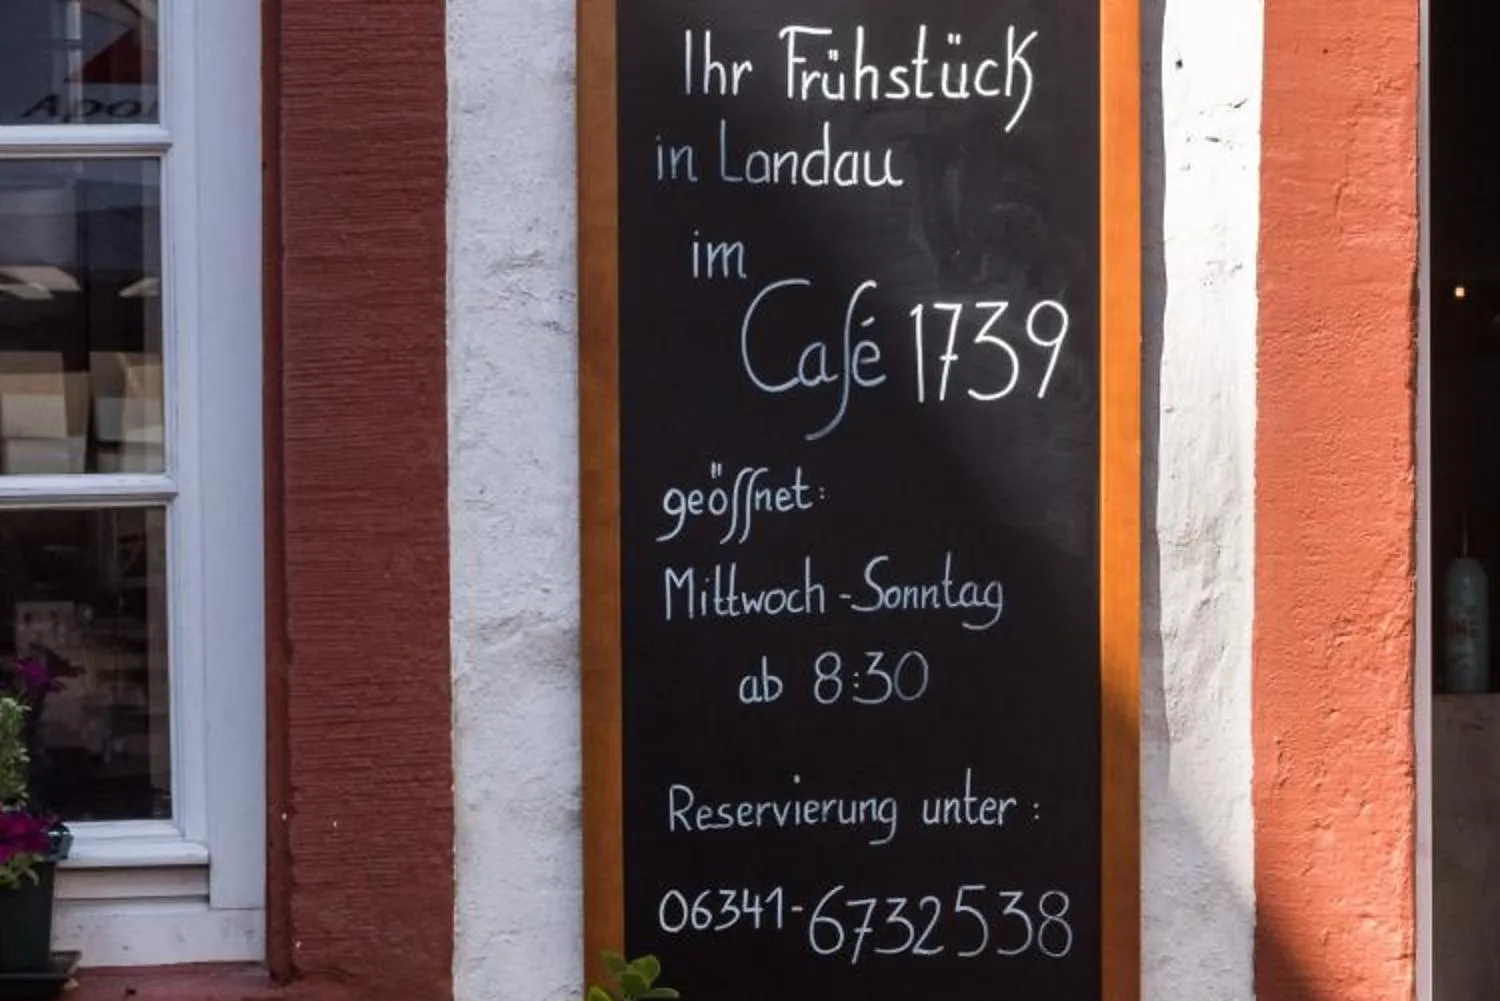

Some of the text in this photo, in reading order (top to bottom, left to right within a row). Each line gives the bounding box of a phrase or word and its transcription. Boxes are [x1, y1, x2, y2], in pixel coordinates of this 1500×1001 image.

[684, 24, 1039, 133] Ihr Frühstück
[655, 118, 905, 188] in Landau
[692, 229, 748, 279] im
[740, 278, 1070, 441] Café 1739
[664, 556, 826, 621] Mittwoch
[738, 650, 929, 705] ab 8:30
[668, 774, 898, 845] Reservierung
[658, 885, 1074, 965] 06341-6732538
